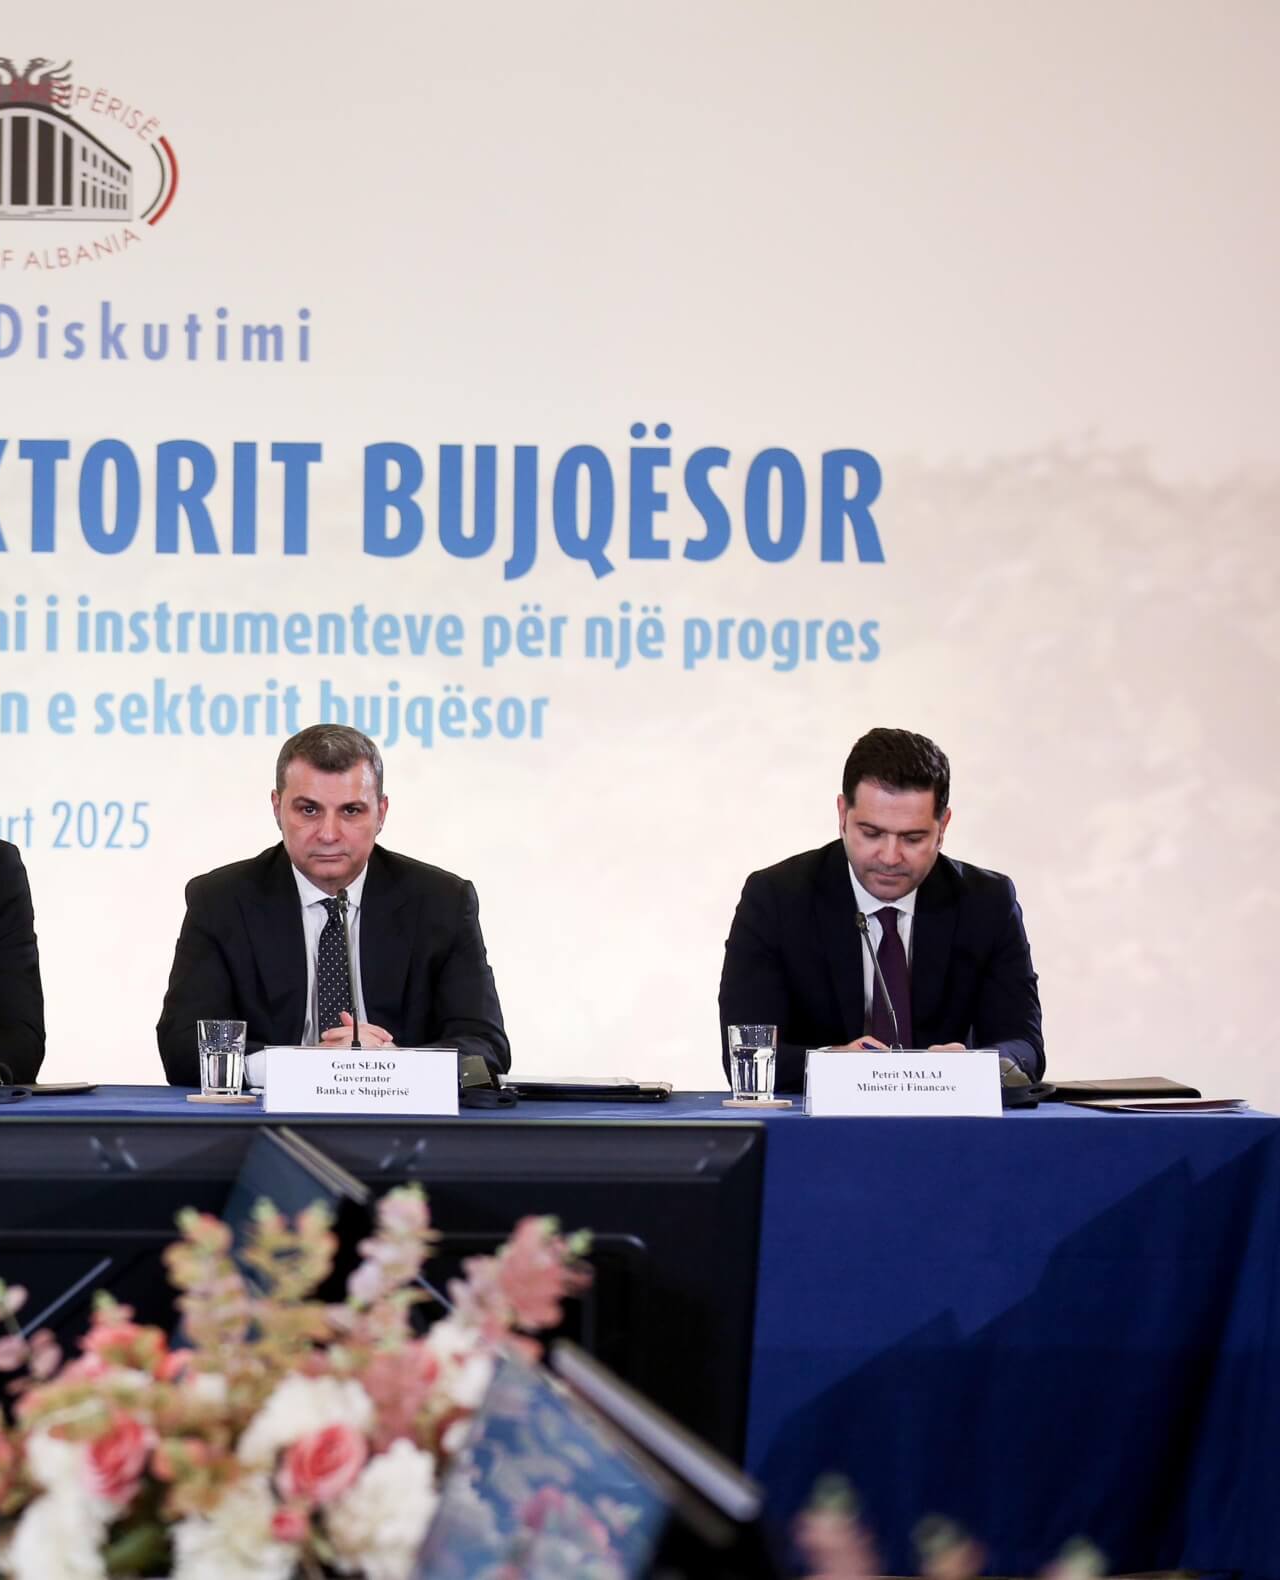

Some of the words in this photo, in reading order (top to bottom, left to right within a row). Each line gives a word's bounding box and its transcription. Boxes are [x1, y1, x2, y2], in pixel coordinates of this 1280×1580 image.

[23, 227, 142, 272] ALBANIA
[363, 422, 885, 581] BUJQËSOR
[46, 594, 59, 652] i
[77, 595, 464, 656] instrumenteve
[482, 603, 568, 668] për
[585, 601, 665, 669] një
[684, 618, 880, 672] progres
[48, 692, 77, 735] e
[94, 676, 302, 736] sektorit
[320, 679, 550, 749] bujqësor
[52, 800, 150, 849] 2025
[331, 1061, 356, 1070] Gent
[358, 1061, 396, 1071] SEJKO
[333, 1073, 390, 1083] Guvernator
[872, 1070, 899, 1079] Petrit
[902, 1070, 942, 1080] MALAJ
[315, 1085, 348, 1096] Banka
[357, 1086, 410, 1098] Shqipërisë
[857, 1082, 899, 1092] Ministër
[906, 1082, 957, 1092] Financave
